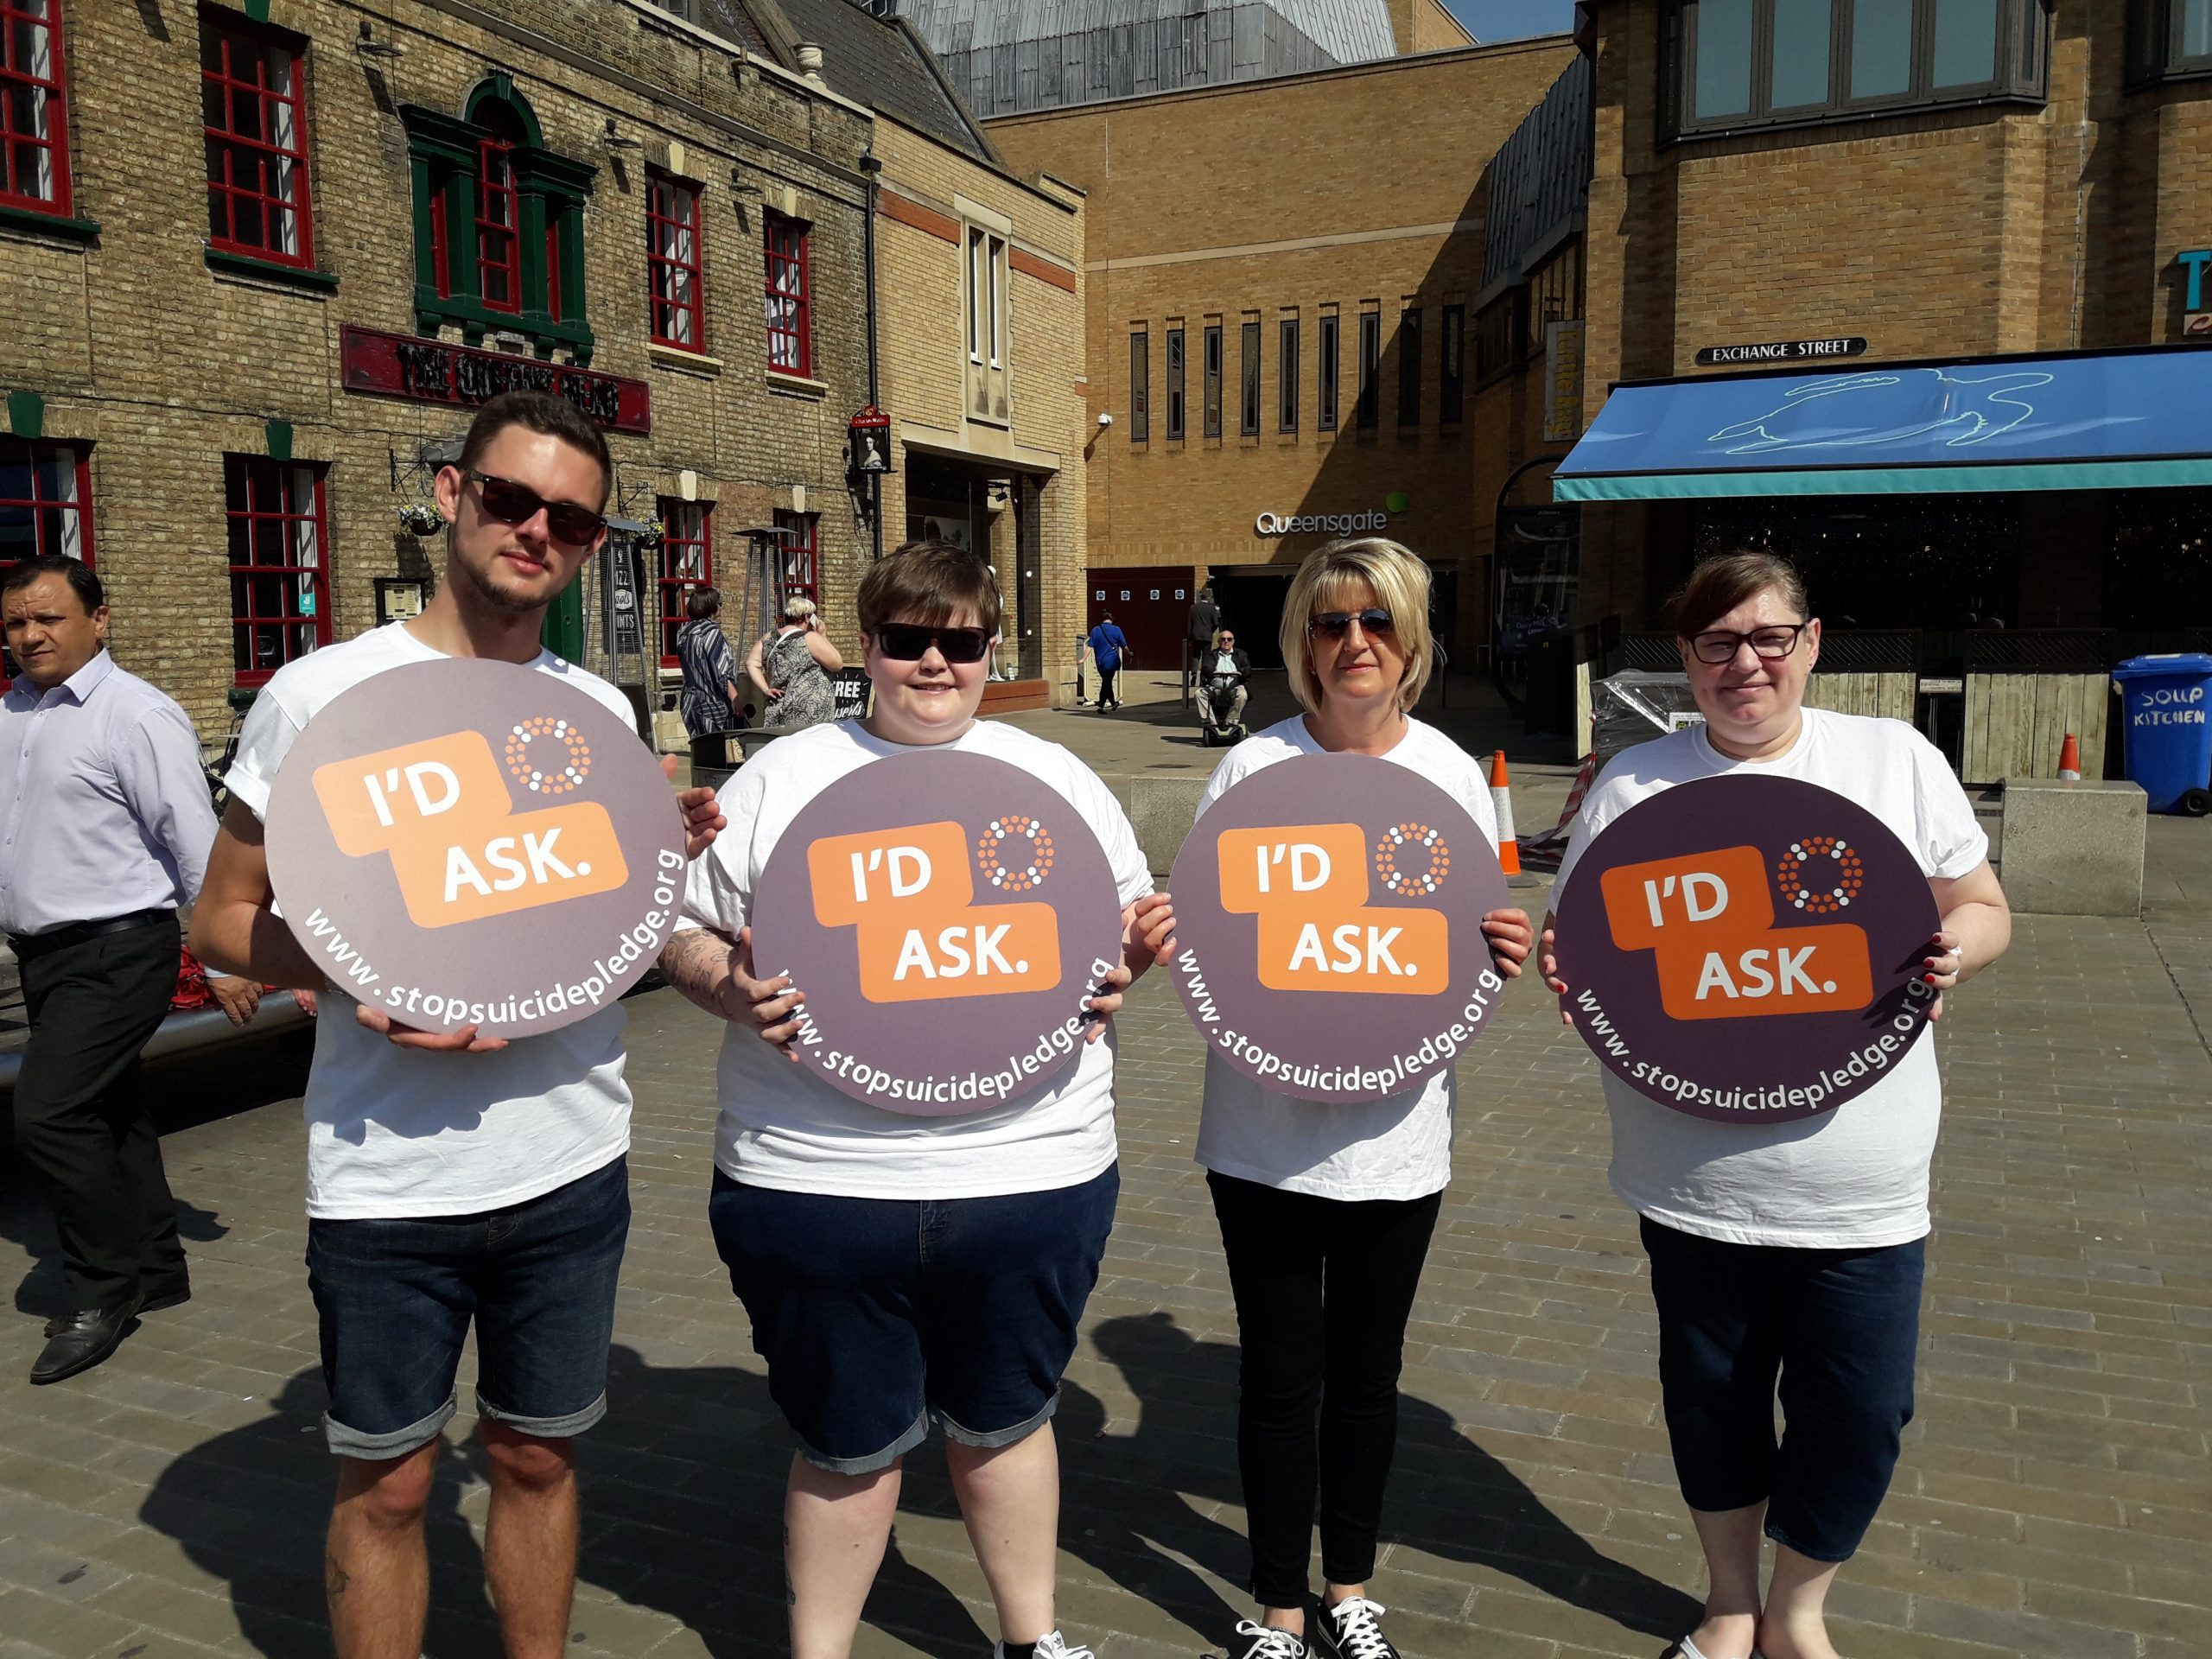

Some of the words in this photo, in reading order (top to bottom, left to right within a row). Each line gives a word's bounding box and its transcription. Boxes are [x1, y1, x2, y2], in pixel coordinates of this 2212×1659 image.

[397, 343, 451, 393] THE
[1713, 344, 1789, 361] EXCHANGE
[1798, 339, 1851, 355] STREET
[1256, 508, 1387, 537] Queensgate
[616, 614, 634, 628] INTS
[833, 680, 861, 698] REE
[2141, 687, 2203, 707] SOUP
[2134, 710, 2205, 726] KITCHEN
[363, 761, 461, 827] I'D
[443, 827, 591, 903] ASK.
[850, 846, 932, 902] I'D
[1256, 842, 1332, 893] I'D
[1643, 872, 1729, 927] I'D
[304, 849, 683, 1026] www.stopsuicidepledge.org
[893, 923, 1029, 981] ASK.
[1287, 923, 1418, 976] ASK.
[1694, 945, 1837, 1000] ASK.
[1179, 948, 1503, 1095] www.stopsuicidepledge.org
[1576, 976, 1934, 1109] www.stopsuicidepledge.org
